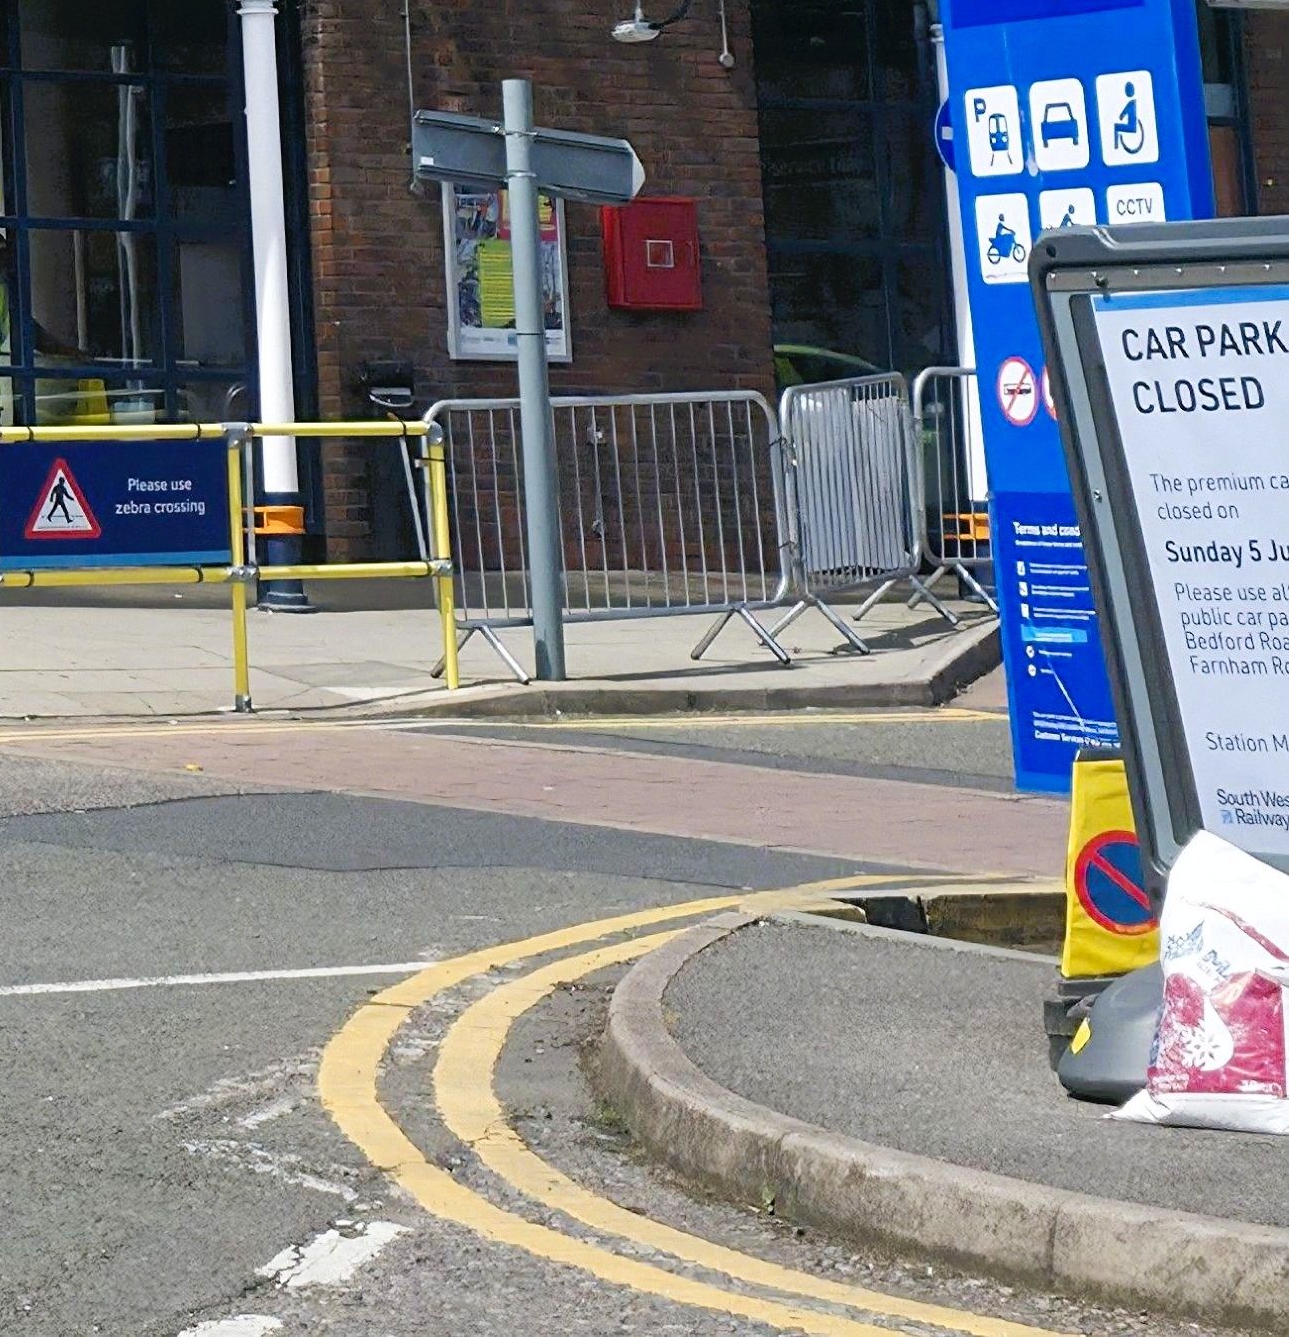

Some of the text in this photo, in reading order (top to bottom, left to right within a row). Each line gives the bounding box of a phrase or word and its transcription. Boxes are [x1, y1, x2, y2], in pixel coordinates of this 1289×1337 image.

[1116, 198, 1153, 216] CCTV
[1122, 320, 1289, 361] CAR PARK
[1132, 376, 1265, 414] CLOSED
[127, 478, 192, 492] Please use
[1149, 472, 1289, 496] The premium ca
[115, 498, 206, 516] zebra crossing
[1157, 501, 1239, 520] closed on
[1059, 525, 1081, 537] cond
[1165, 539, 1289, 568] Sunday 5 Ju
[1174, 582, 1289, 601] Please use al
[1181, 607, 1289, 631] public car pa
[1185, 631, 1289, 651] Bedford Roa
[1189, 655, 1289, 675] Farnham Ro
[1205, 732, 1289, 752] Station M
[1216, 788, 1289, 808] South Wes
[1234, 807, 1289, 831] Railway
